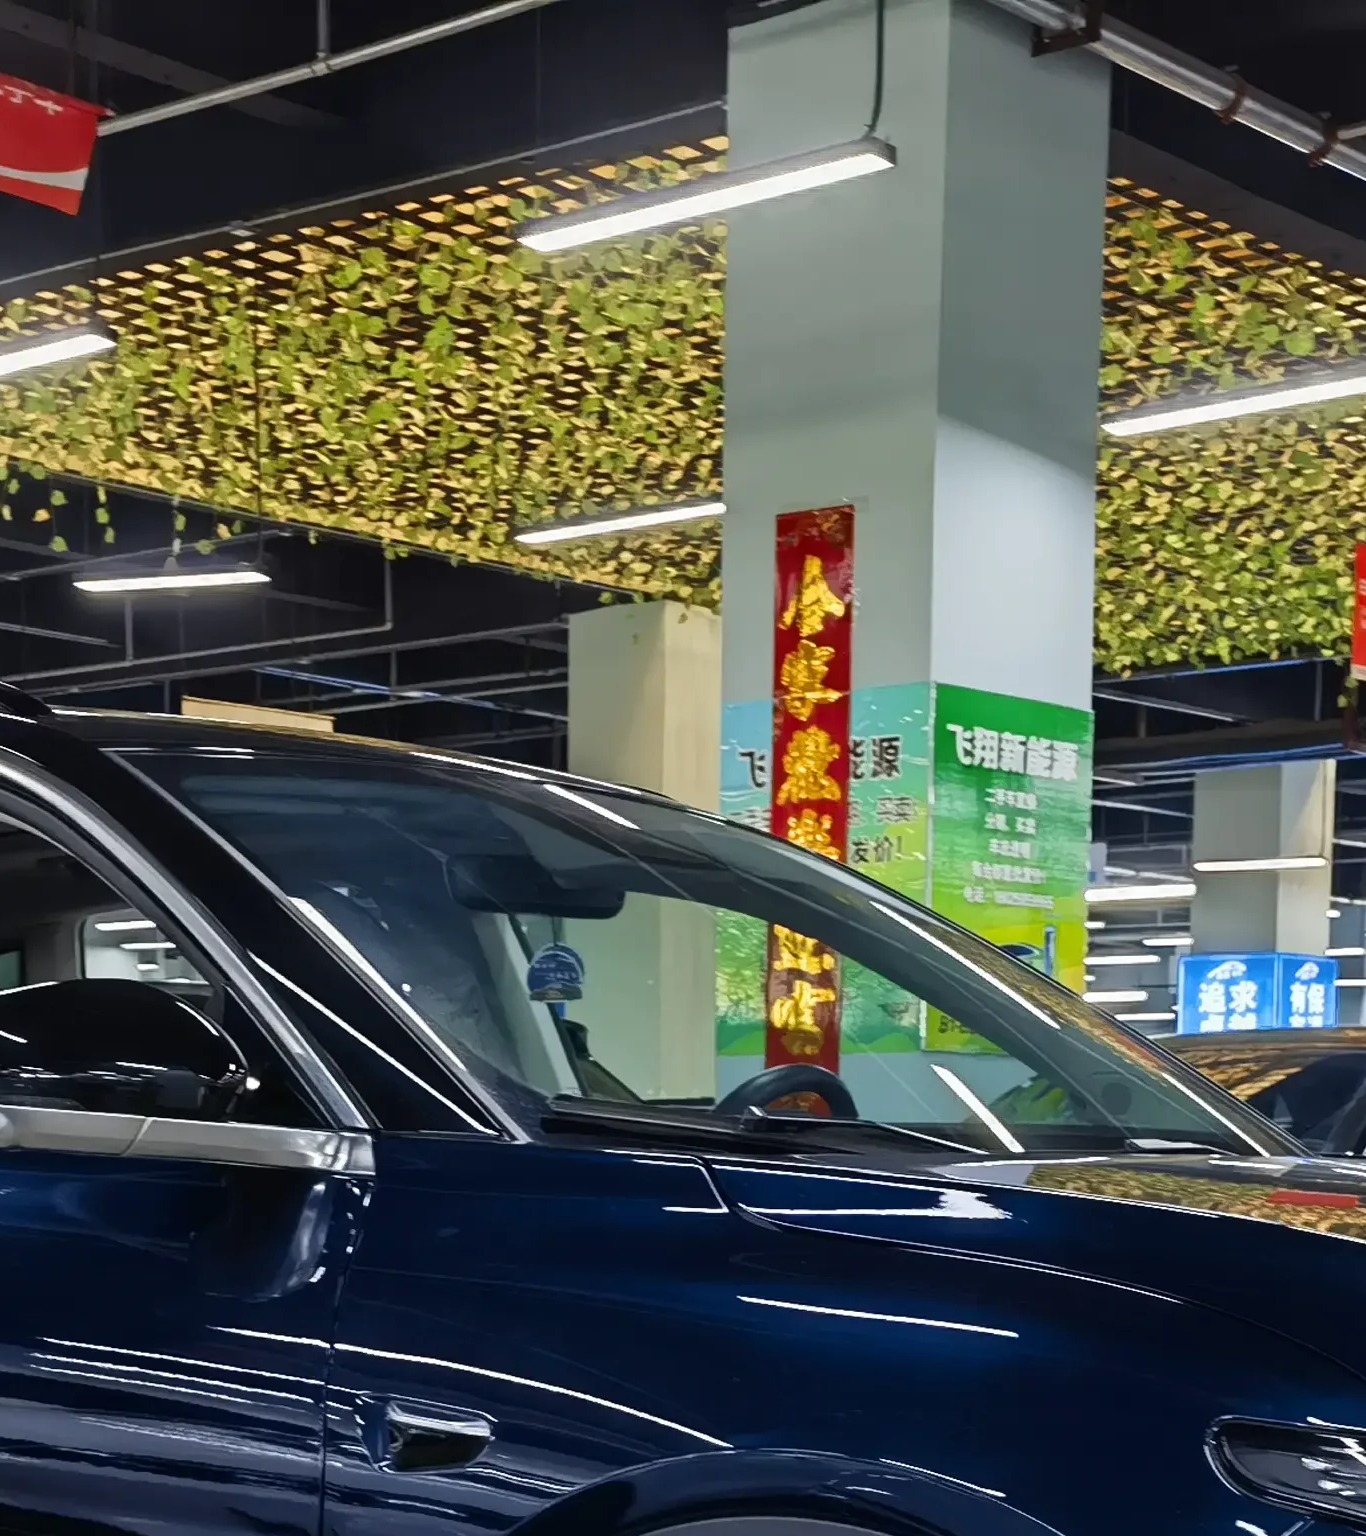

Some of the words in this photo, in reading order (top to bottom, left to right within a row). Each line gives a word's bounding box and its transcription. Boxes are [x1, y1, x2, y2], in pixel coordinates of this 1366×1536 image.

[946, 723, 1080, 781] 飞翔新能源
[1198, 980, 1259, 1014] 追求
